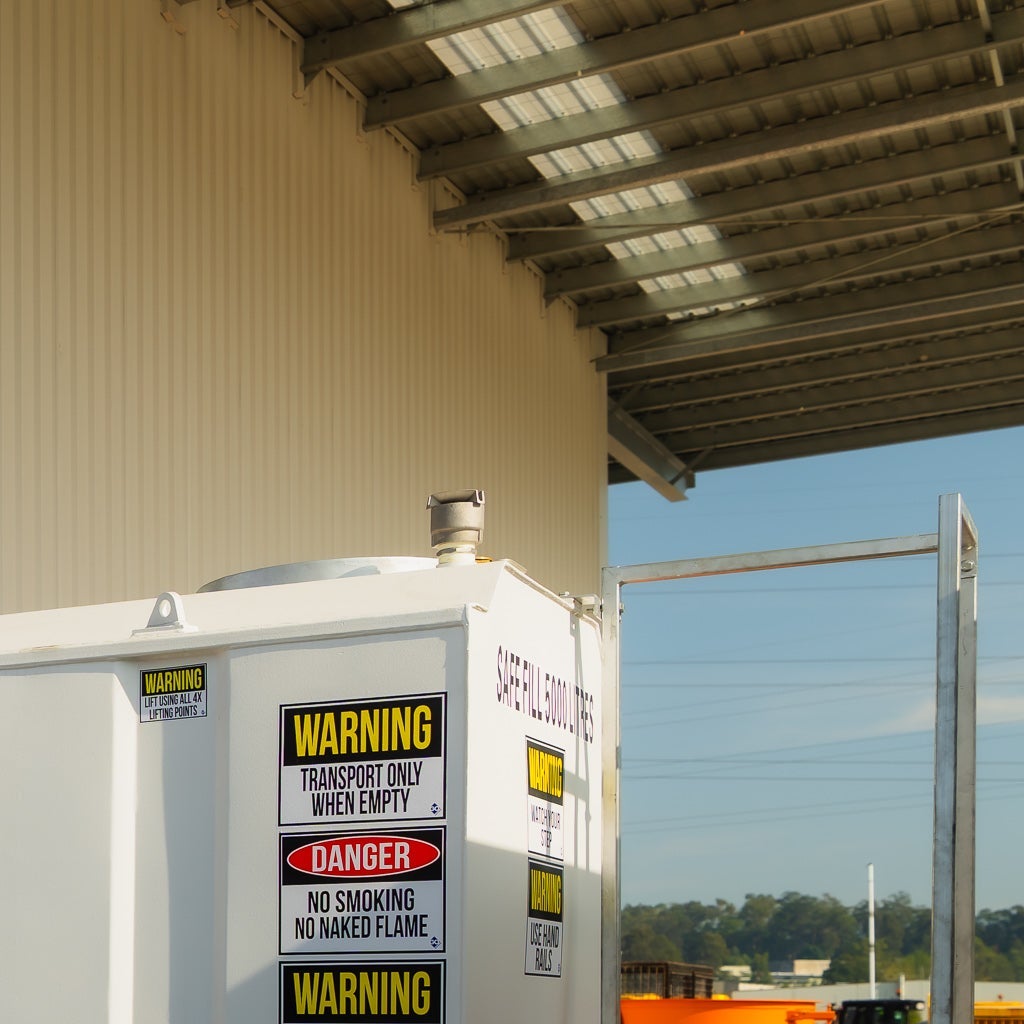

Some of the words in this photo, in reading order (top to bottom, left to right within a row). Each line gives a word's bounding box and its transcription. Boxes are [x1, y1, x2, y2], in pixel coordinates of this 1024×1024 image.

[145, 668, 202, 694] WARNING
[145, 697, 158, 707] LIFT
[159, 694, 178, 706] USING
[180, 693, 191, 704] ALL
[193, 692, 202, 702] 4X
[497, 645, 520, 711] SAFE
[523, 660, 542, 720] FILL
[545, 673, 567, 730] 5000
[569, 682, 594, 744] LITRES
[150, 708, 173, 719] LIFTING
[175, 705, 197, 717] POINTS
[294, 705, 432, 757] WARNING
[301, 764, 383, 791] TRANSPORT
[387, 761, 423, 787] ONLY
[528, 747, 563, 797] WARNING
[312, 791, 354, 816] WHEN
[360, 788, 410, 814] EMPTY
[531, 804, 547, 824] WATCH
[548, 809, 560, 829] YOUR
[541, 829, 552, 848] STEP
[311, 842, 410, 872] DANGER
[308, 890, 330, 913] NO
[336, 888, 415, 912] SMOKING
[531, 869, 561, 914] WARNING
[295, 917, 315, 939] NO
[319, 915, 371, 939] NAKED
[376, 914, 428, 938] FLAME
[531, 922, 542, 946] USE
[543, 925, 559, 948] HAND
[535, 948, 552, 971] RAILS
[293, 971, 431, 1015] WARNING
